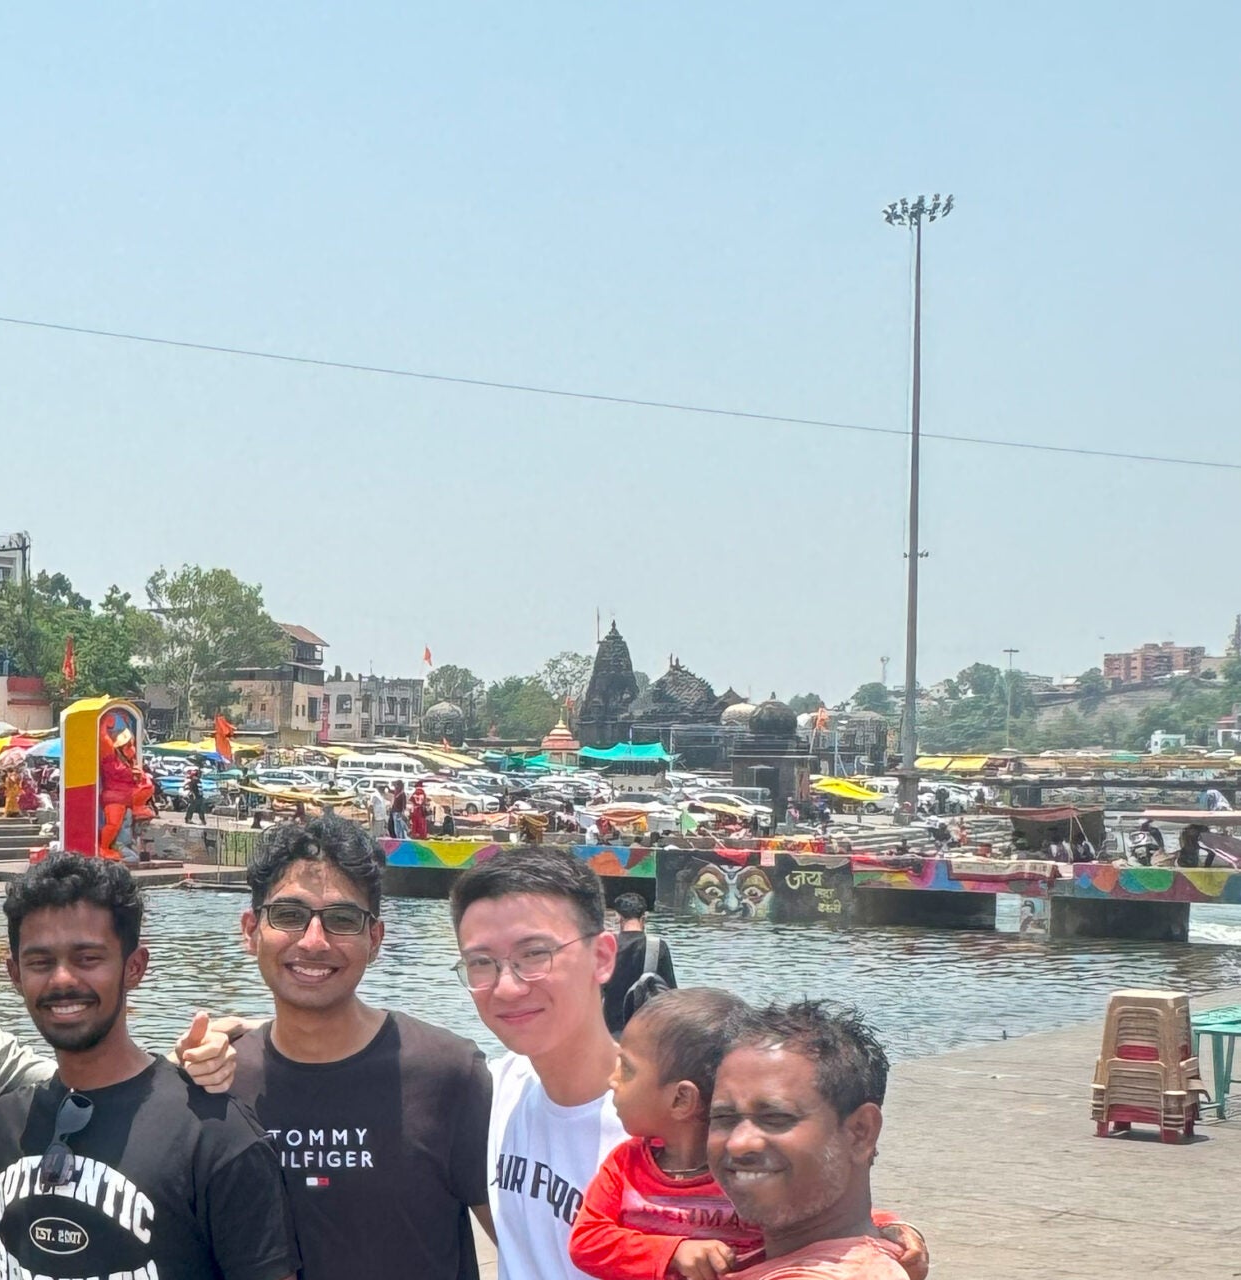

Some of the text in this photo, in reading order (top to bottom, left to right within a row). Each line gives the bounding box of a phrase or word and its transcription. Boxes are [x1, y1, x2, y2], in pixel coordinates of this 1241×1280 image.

[266, 1127, 367, 1147] TOMMY
[281, 1150, 374, 1169] ILFIGER
[490, 1153, 528, 1194] AIR
